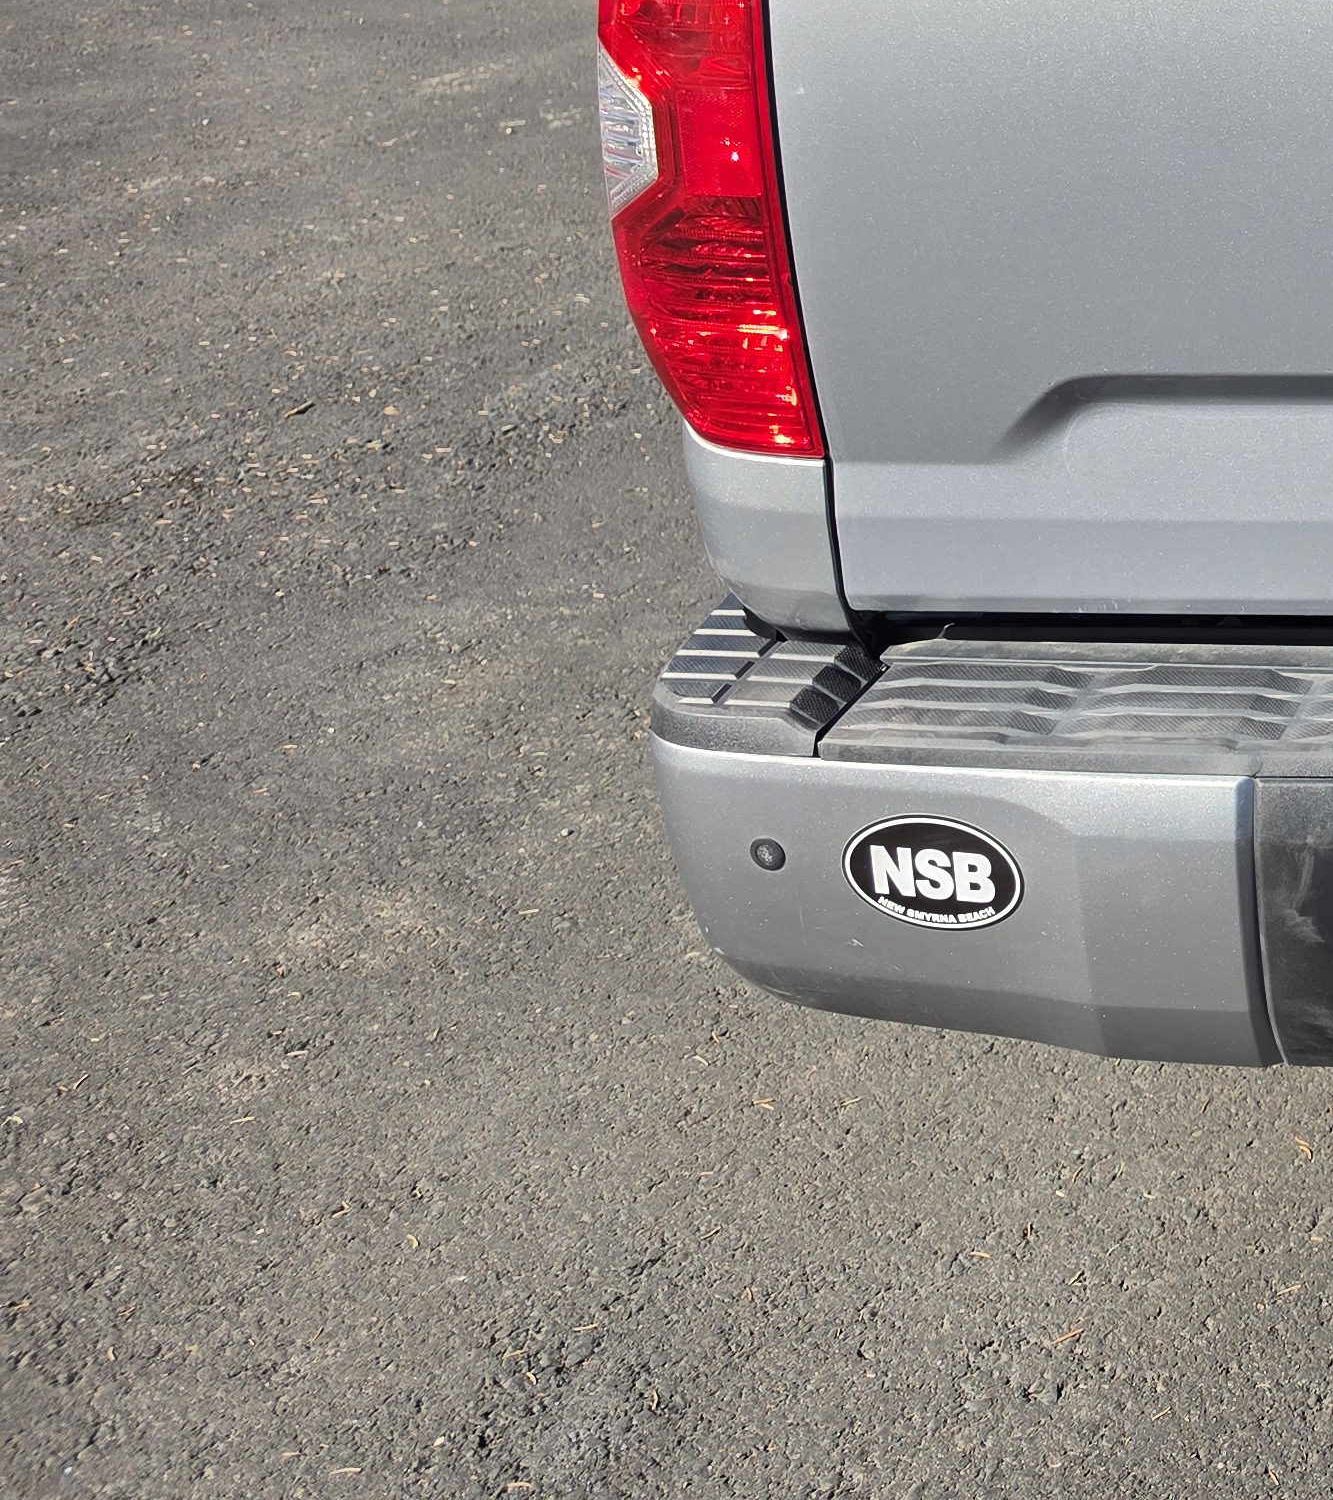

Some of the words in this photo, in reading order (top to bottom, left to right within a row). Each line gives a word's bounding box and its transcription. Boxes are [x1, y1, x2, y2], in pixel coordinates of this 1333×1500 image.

[869, 844, 996, 904] NSB
[877, 896, 906, 915] NEW
[906, 908, 958, 924] SMYRNA
[958, 905, 996, 924] BEACH
